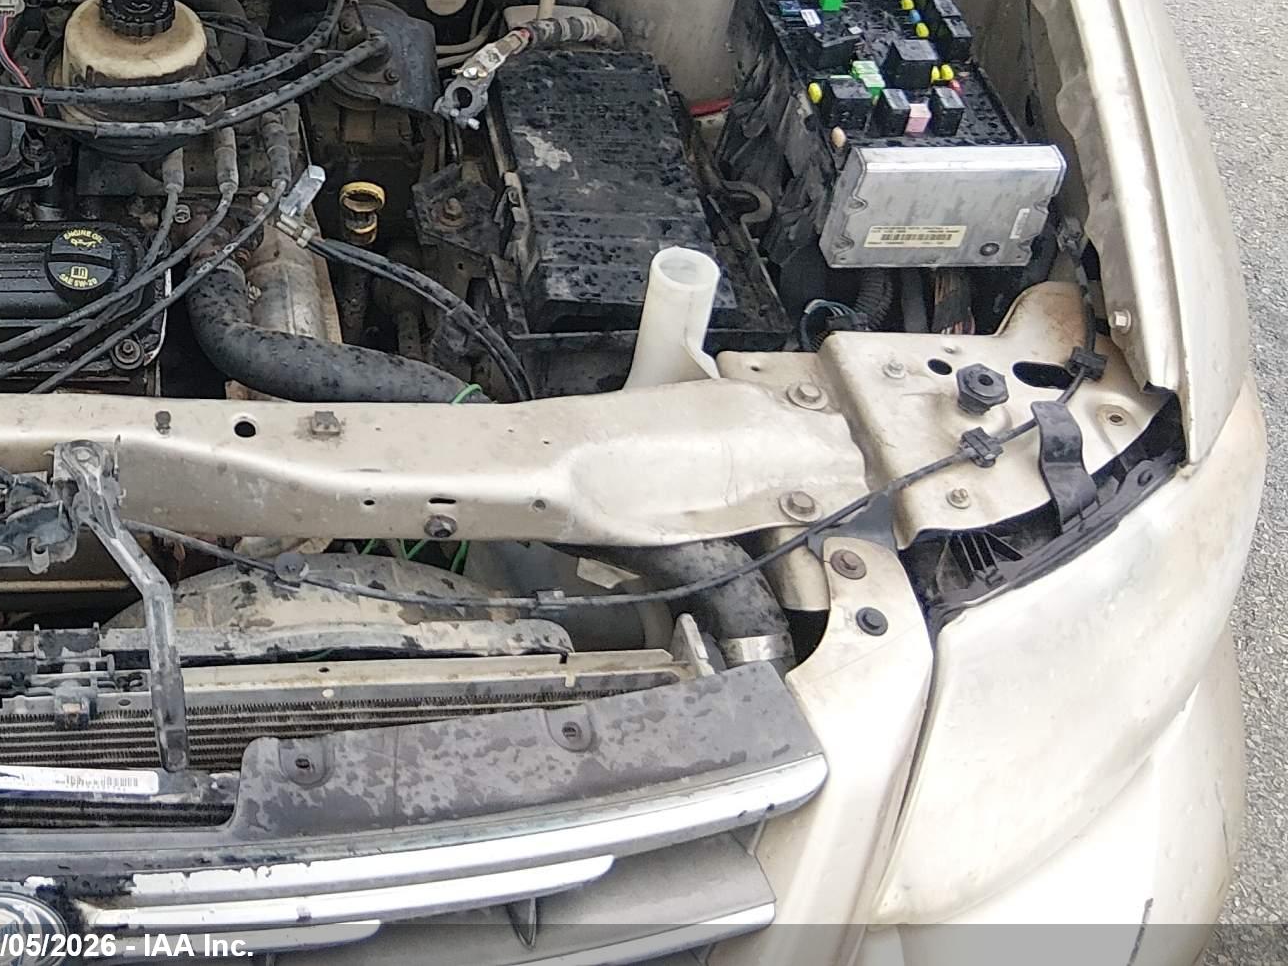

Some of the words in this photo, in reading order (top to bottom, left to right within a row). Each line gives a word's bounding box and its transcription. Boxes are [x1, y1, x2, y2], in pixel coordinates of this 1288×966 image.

[63, 229, 92, 240] ENGINE
[92, 233, 104, 244] OIL
[58, 273, 73, 285] SAE
[73, 277, 98, 287] 5W-20
